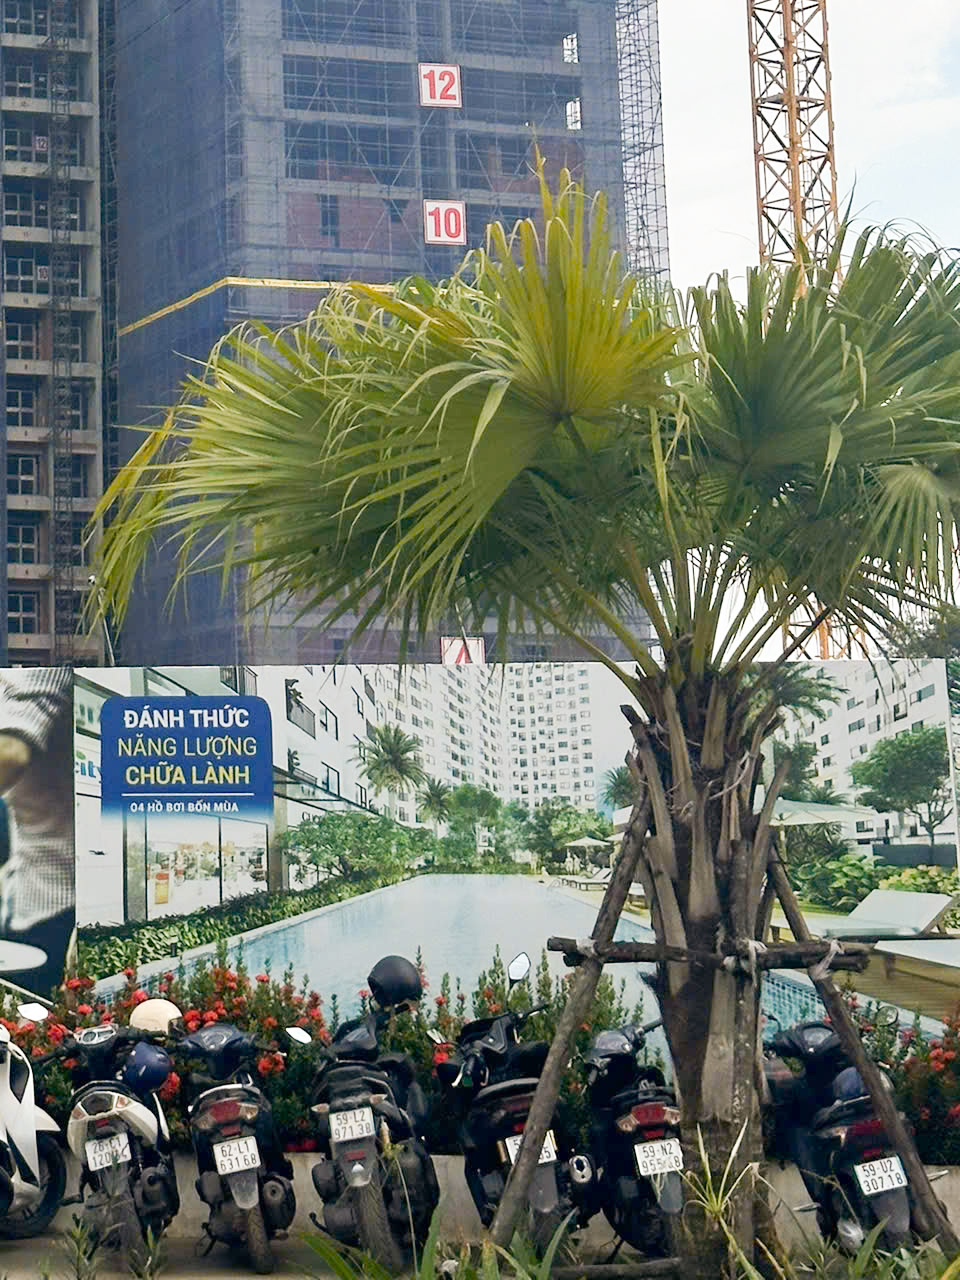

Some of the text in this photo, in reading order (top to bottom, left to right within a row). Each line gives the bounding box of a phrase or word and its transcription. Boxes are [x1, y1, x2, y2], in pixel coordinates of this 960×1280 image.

[422, 69, 457, 101] 12
[428, 206, 462, 239] 10
[123, 705, 185, 729] ĐÁNH
[189, 704, 250, 729] THỨC
[118, 734, 257, 760] NĂNG LƯỢNG
[125, 762, 250, 785] CHỮA LÀNH
[130, 800, 239, 813] 04 HỒ BƠI BỐN MÙA
